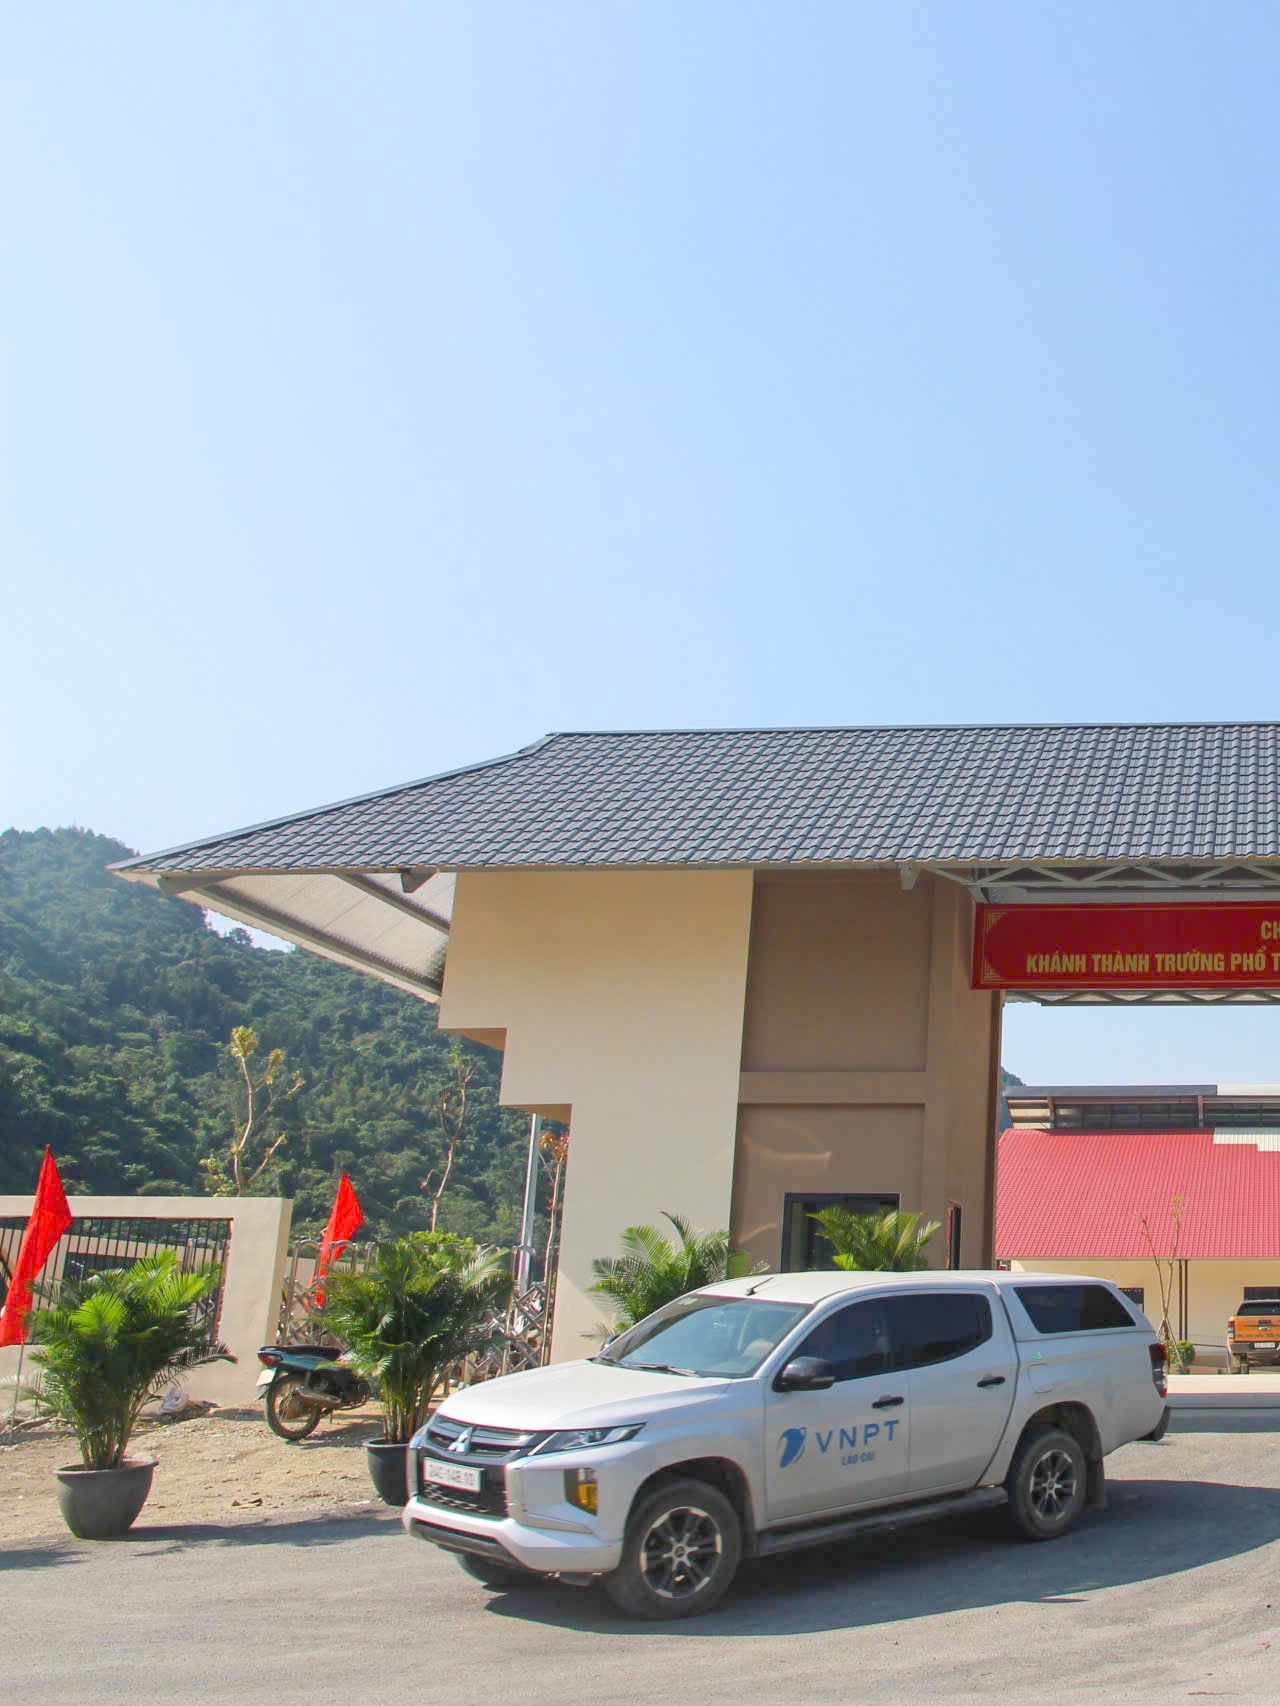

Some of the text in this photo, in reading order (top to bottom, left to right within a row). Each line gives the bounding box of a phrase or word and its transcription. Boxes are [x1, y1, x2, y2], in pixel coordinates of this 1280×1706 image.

[1026, 949, 1087, 973] KHÁNH
[1093, 949, 1150, 973] THÀNH
[1155, 947, 1224, 973] TRƯỜNG
[1230, 945, 1267, 972] PHỔ
[815, 1419, 900, 1454] VNPT
